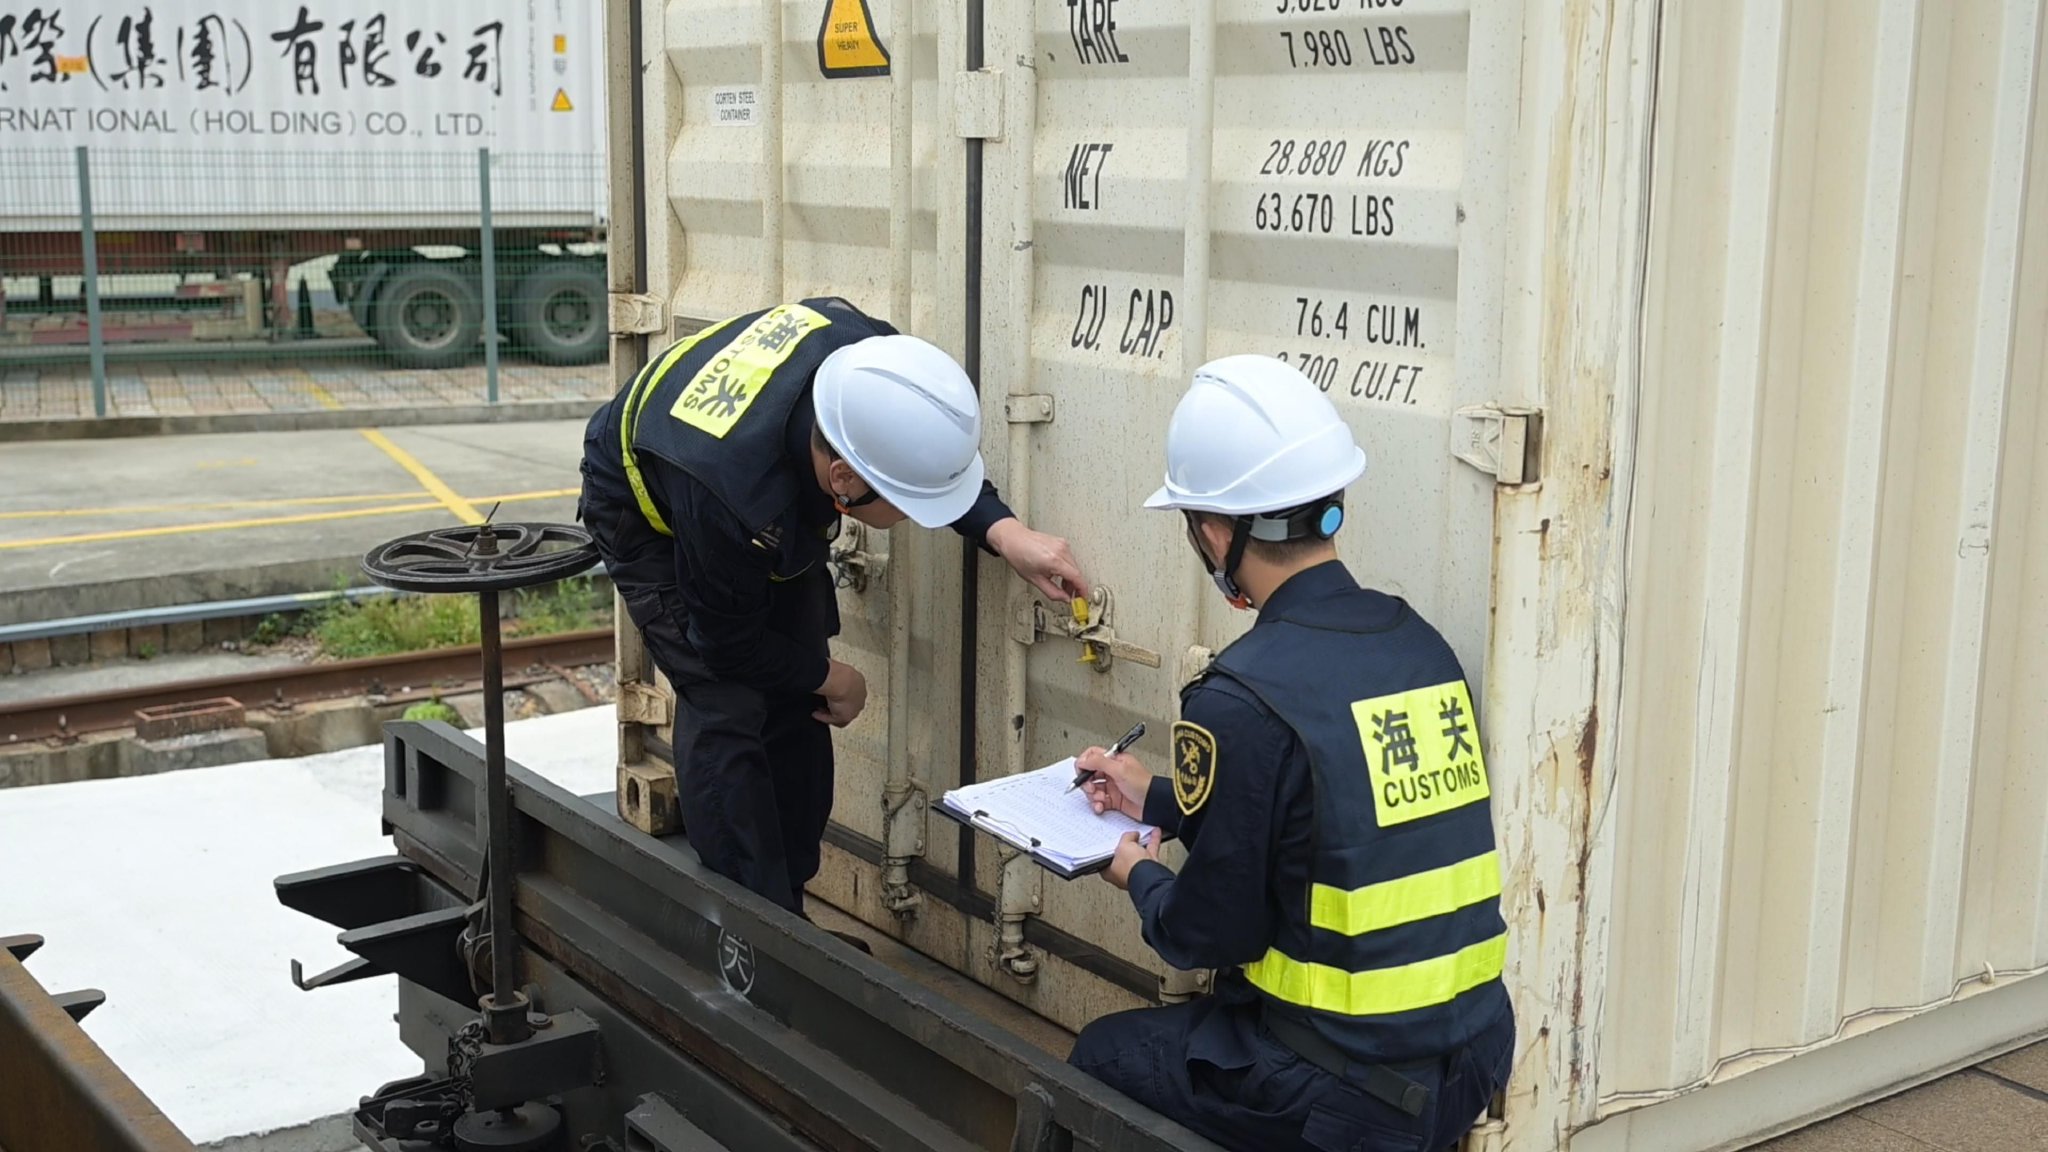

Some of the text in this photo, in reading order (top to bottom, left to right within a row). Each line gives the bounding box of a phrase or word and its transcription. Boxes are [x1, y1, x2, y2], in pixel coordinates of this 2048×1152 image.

[834, 21, 858, 34] SUPER
[836, 39, 860, 51] HEAVY
[1067, 0, 1129, 64] TARE
[1363, 26, 1415, 65] LBS
[715, 91, 756, 105] CORTEN STEEL
[720, 108, 751, 121] CONTAINER
[1064, 143, 1114, 211] NET
[1356, 139, 1410, 178] KGS
[1351, 194, 1395, 237] LBS
[1119, 288, 1174, 359] CAP.
[1296, 297, 1426, 349] 76.4 CU.M.
[682, 309, 787, 410] CUSTOMS
[697, 312, 811, 419] 海关
[1349, 360, 1424, 405] CU.FT.
[1371, 696, 1474, 776] 海关
[1382, 760, 1481, 808] CUSTOMS
